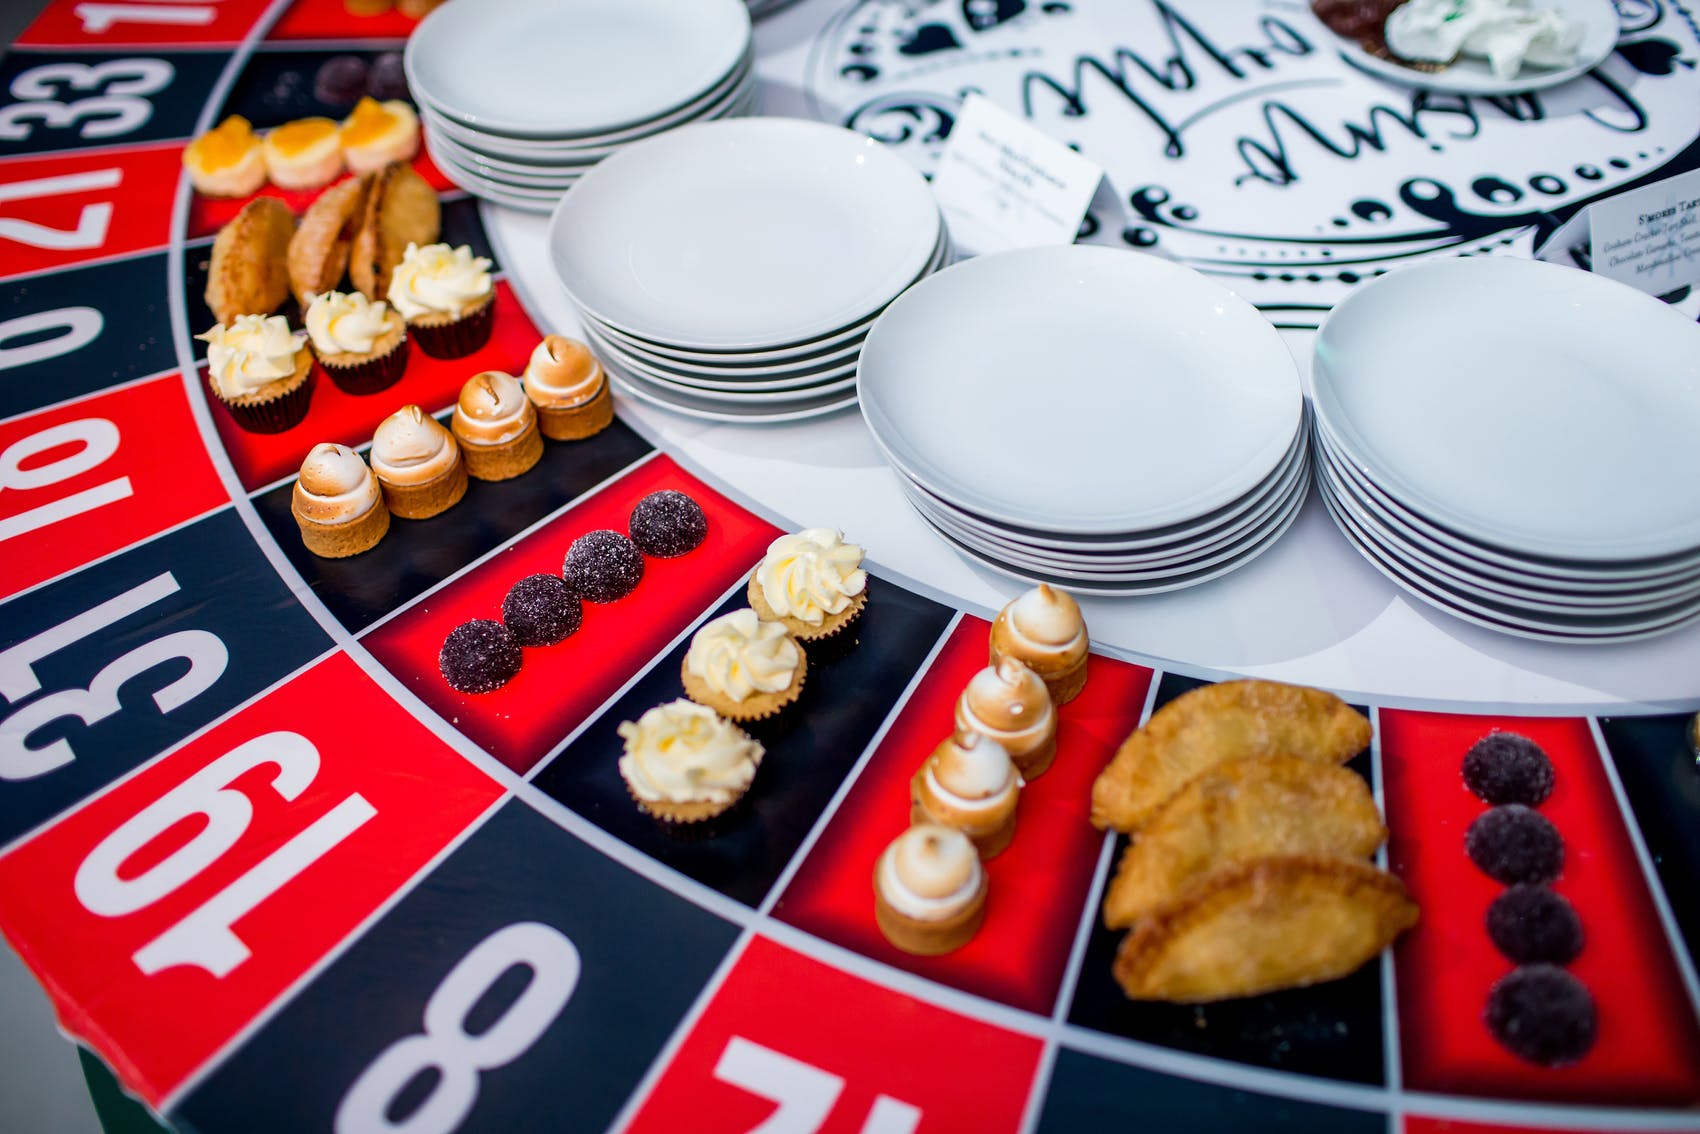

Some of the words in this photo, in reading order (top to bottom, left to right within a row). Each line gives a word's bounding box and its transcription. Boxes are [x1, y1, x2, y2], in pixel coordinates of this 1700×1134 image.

[0, 57, 175, 141] 33
[0, 571, 229, 780] 31
[74, 731, 378, 979] 19
[334, 921, 581, 1134] 8
